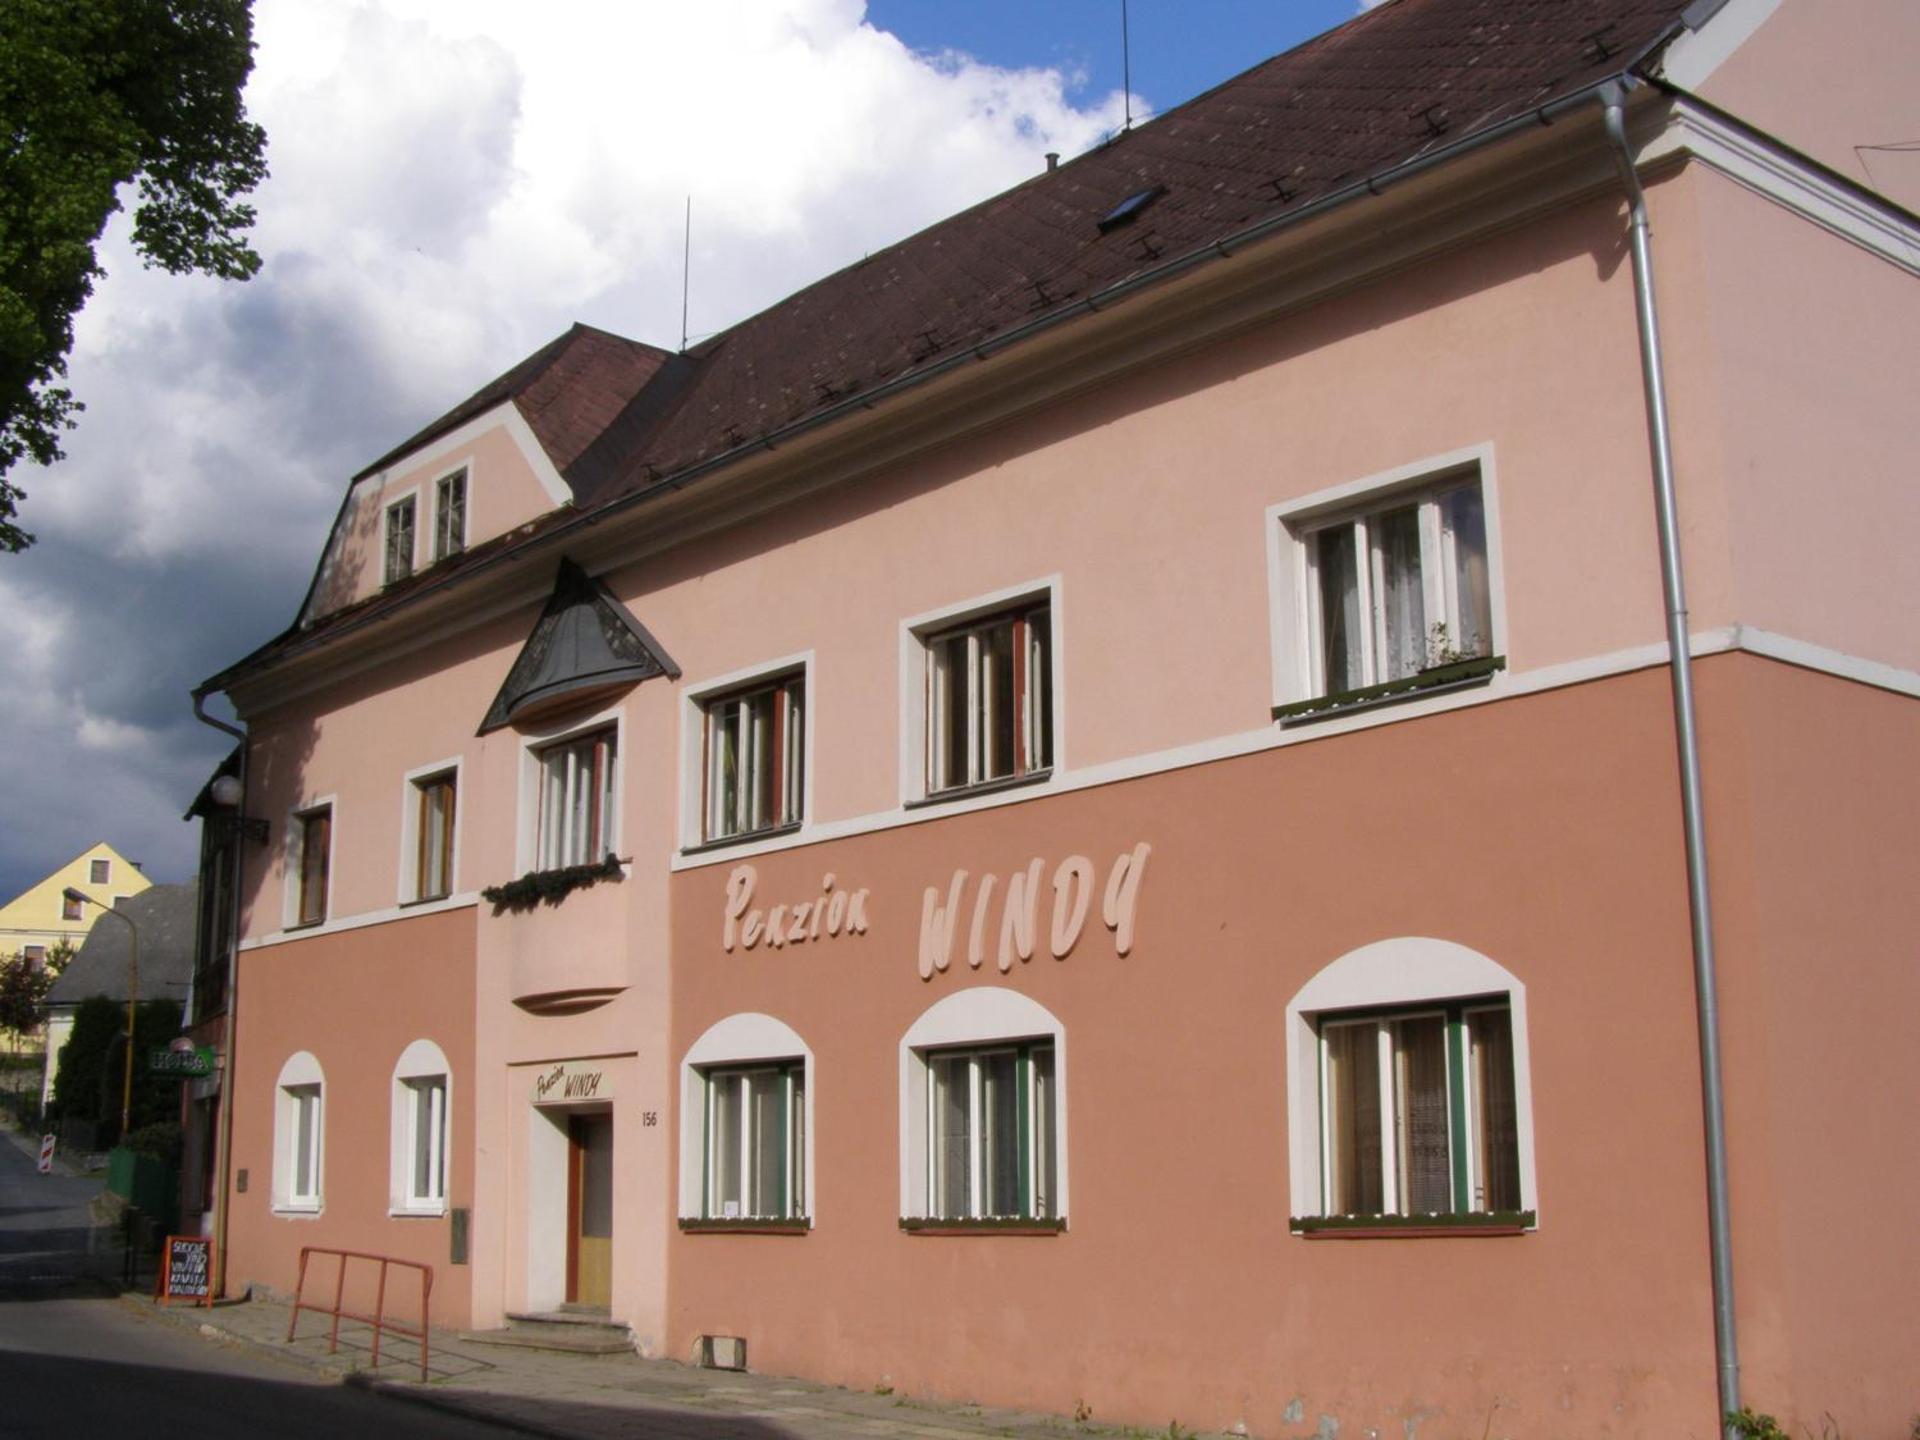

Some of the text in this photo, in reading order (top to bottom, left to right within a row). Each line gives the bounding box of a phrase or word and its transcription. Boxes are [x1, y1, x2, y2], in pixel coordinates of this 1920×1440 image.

[723, 842, 1152, 980] Penzion WINDY
[564, 1072, 602, 1098] WINDY
[642, 1111, 658, 1127] 156
